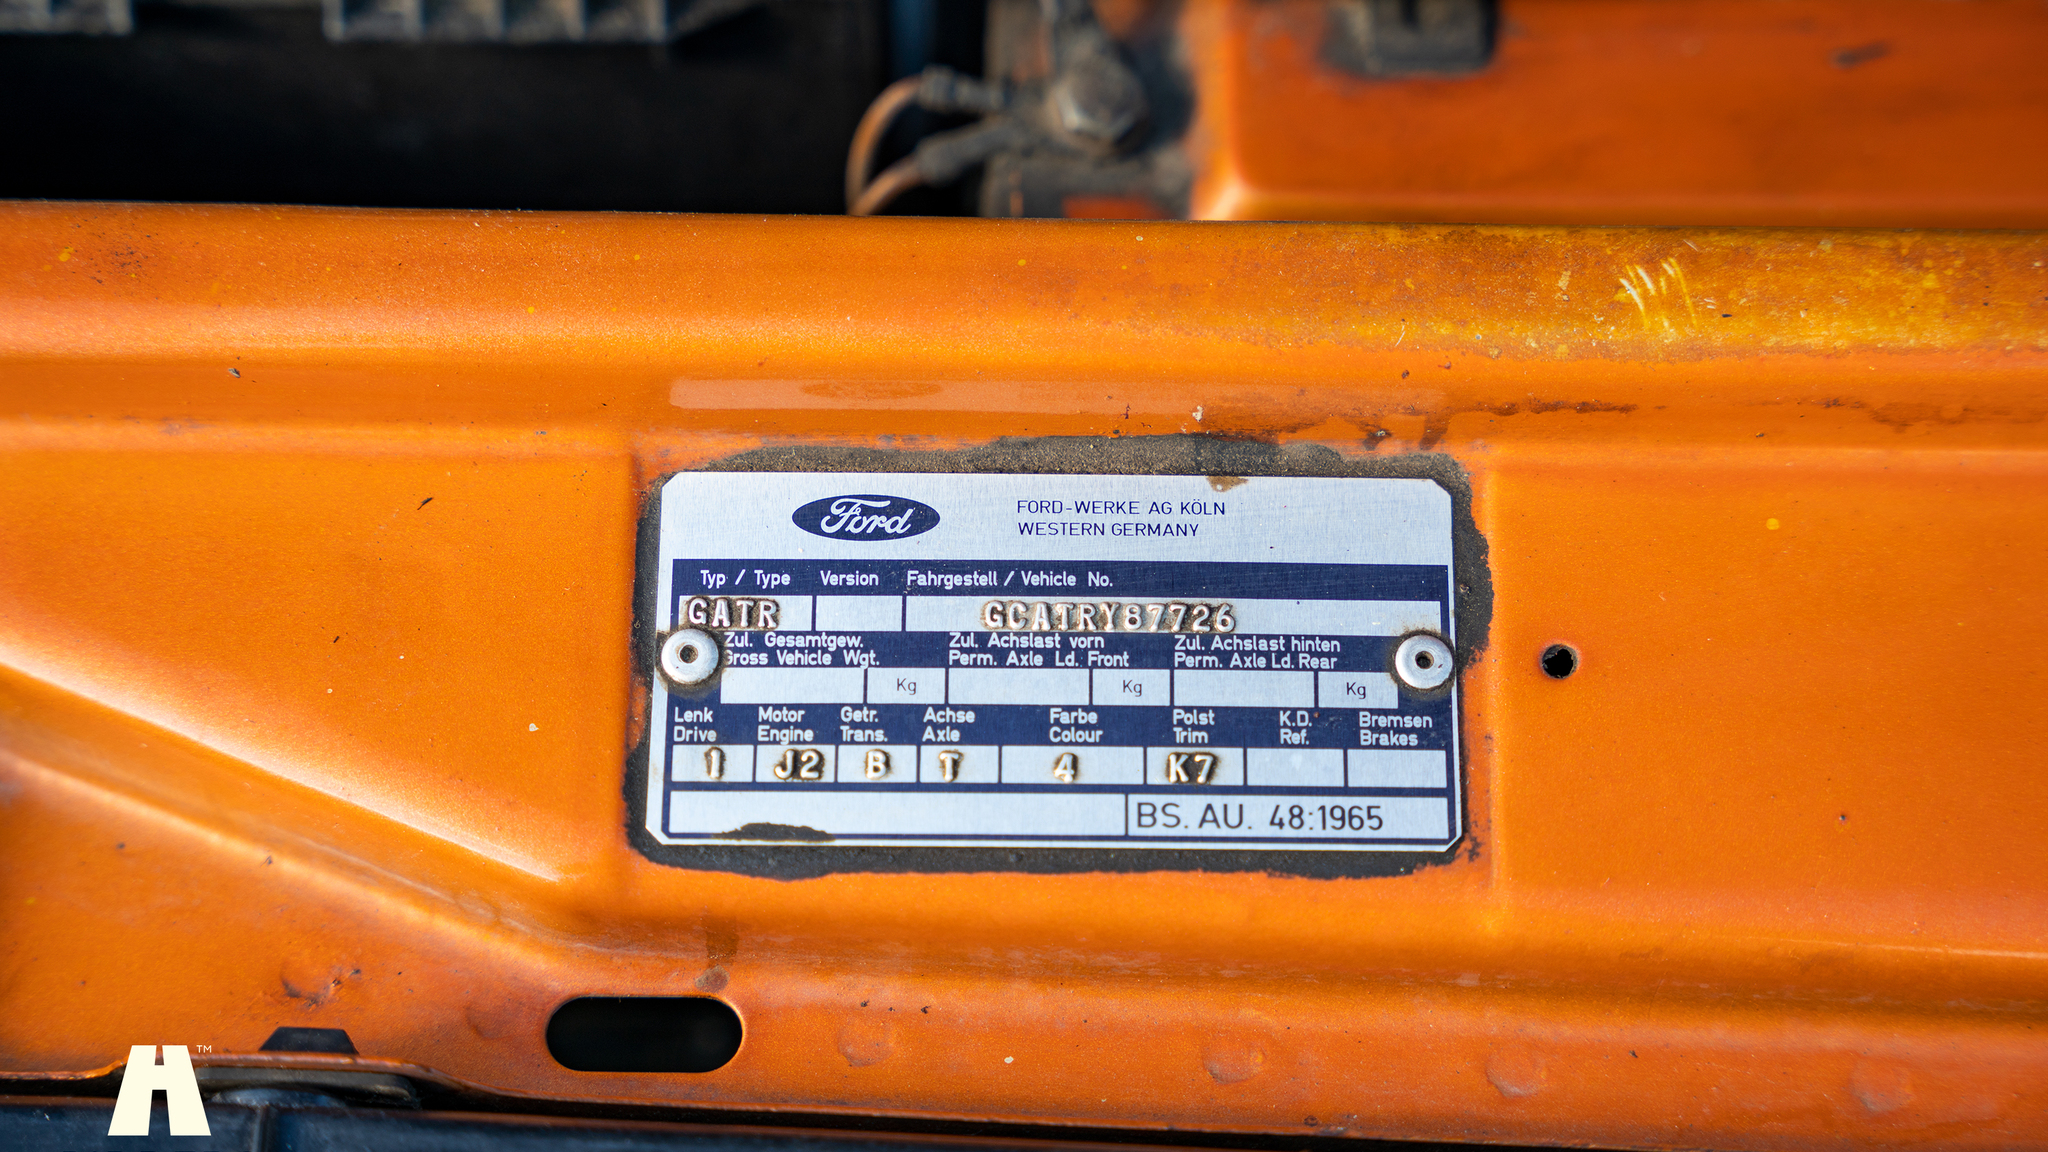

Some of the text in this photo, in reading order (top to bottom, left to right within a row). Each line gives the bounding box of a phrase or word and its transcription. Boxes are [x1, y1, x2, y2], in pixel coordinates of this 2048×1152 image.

[1017, 498, 1225, 515] FORD-WERKE AG KÖLN
[820, 498, 914, 534] Ford
[1018, 522, 1199, 537] WESTERN GERMANY
[700, 569, 791, 589] Typ / Type
[820, 570, 879, 586] Version
[907, 570, 1113, 590] Fahrgestell / Vehicle No.
[688, 598, 779, 628] GATR
[984, 600, 1235, 633] GCATRY87726
[724, 632, 863, 651] Zul. Gesamtgew.
[949, 632, 1105, 649] Zul. Achslast vorn
[1174, 635, 1340, 652] Zul. Achslast hinten
[776, 650, 832, 665] Vehicle
[843, 650, 880, 669] Wgt.
[949, 650, 1130, 667] Perm. Axle Ld. Front
[1174, 652, 1337, 669] Perm. Axle Ld. Rear
[896, 678, 917, 695] Kg
[1122, 680, 1142, 697] Kg
[1346, 682, 1366, 699] Kg
[674, 707, 713, 723] Lenk
[758, 707, 805, 723] Motor
[840, 707, 878, 723] Getr.
[923, 707, 975, 723] Achse
[1049, 708, 1098, 725] Farbe
[1172, 709, 1215, 726] Polst
[1279, 711, 1312, 727] K.D.
[1359, 712, 1433, 728] Bremsen
[673, 726, 717, 742] Drive
[757, 726, 814, 745] Engine
[840, 726, 888, 742] Trans.
[922, 726, 960, 742] Axle
[1049, 727, 1103, 743] Colour
[1173, 727, 1208, 744] Trim
[1280, 728, 1310, 745] Ref.
[1360, 730, 1418, 746] Brakes
[774, 749, 820, 780] J2
[866, 750, 888, 779] B
[939, 750, 961, 782] T
[1054, 753, 1076, 784] 4
[1168, 753, 1215, 784] K7
[1137, 803, 1383, 831] BS. AU. 48:1965
